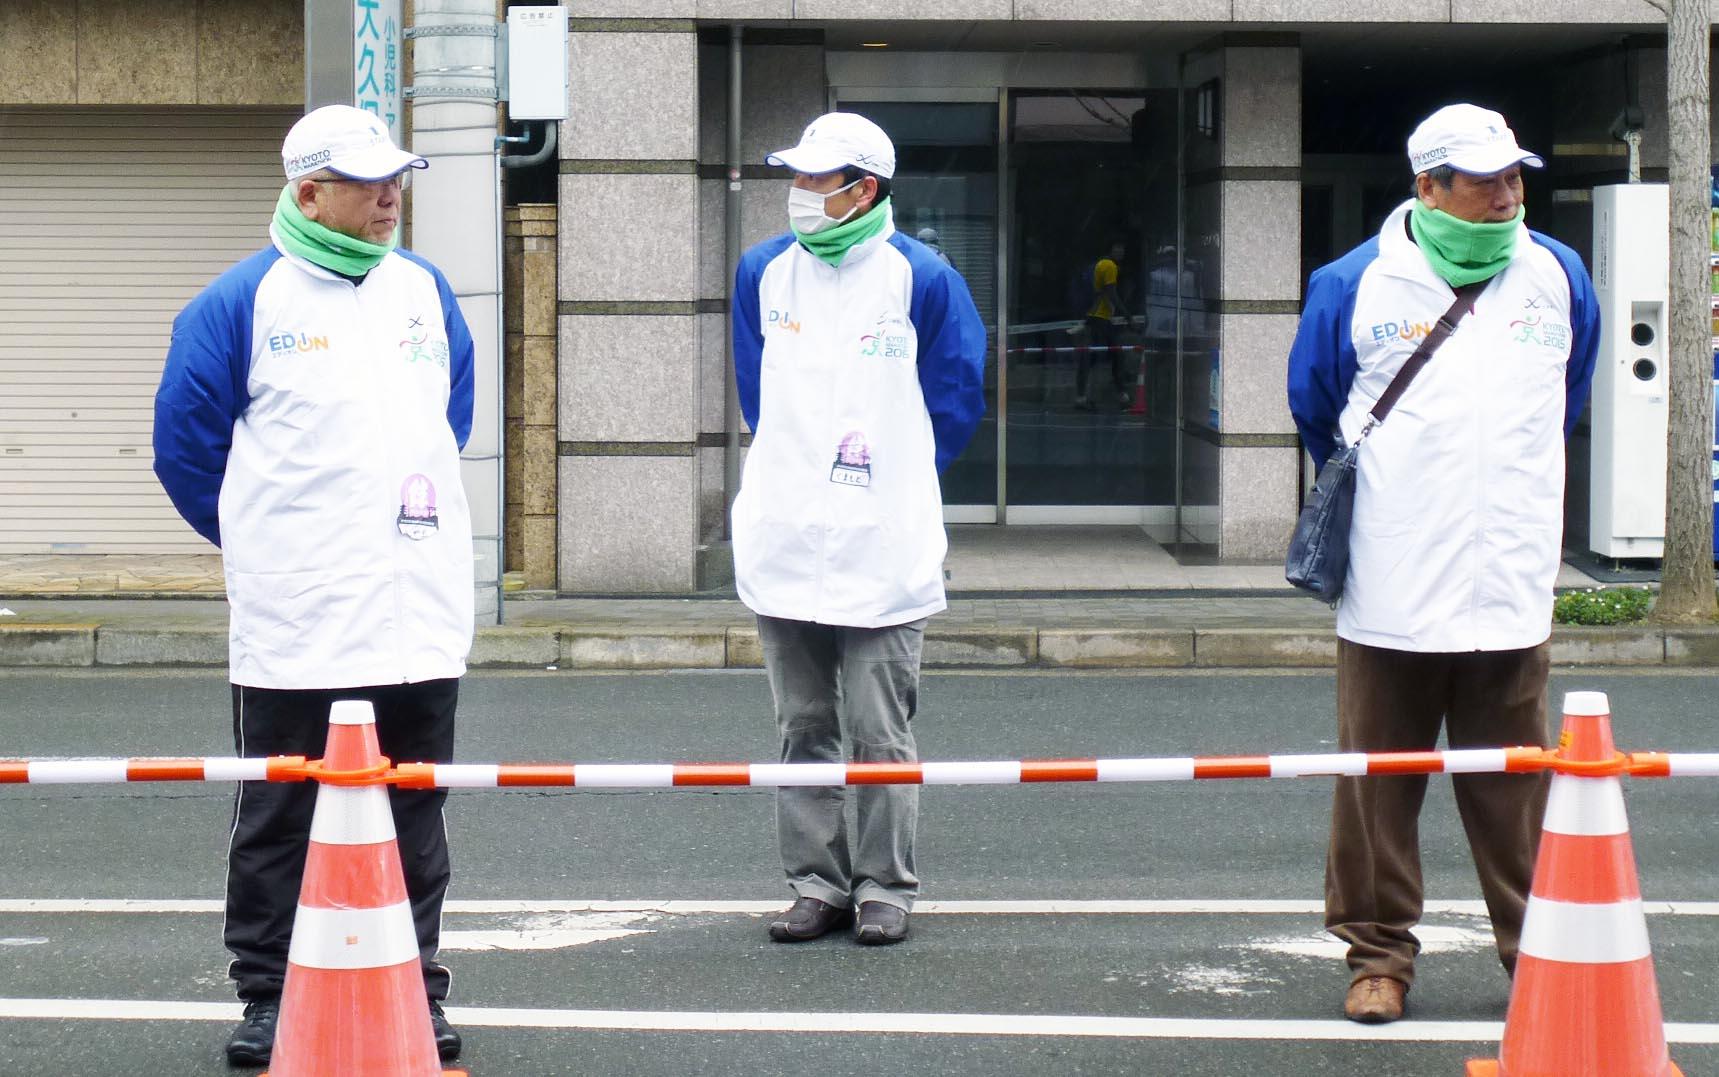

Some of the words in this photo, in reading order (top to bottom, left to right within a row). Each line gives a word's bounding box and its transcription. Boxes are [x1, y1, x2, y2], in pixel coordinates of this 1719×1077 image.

[301, 149, 331, 164] KYOTO
[1422, 146, 1447, 160] KYOTO
[1371, 320, 1432, 341] EDION
[268, 332, 329, 352] EDION
